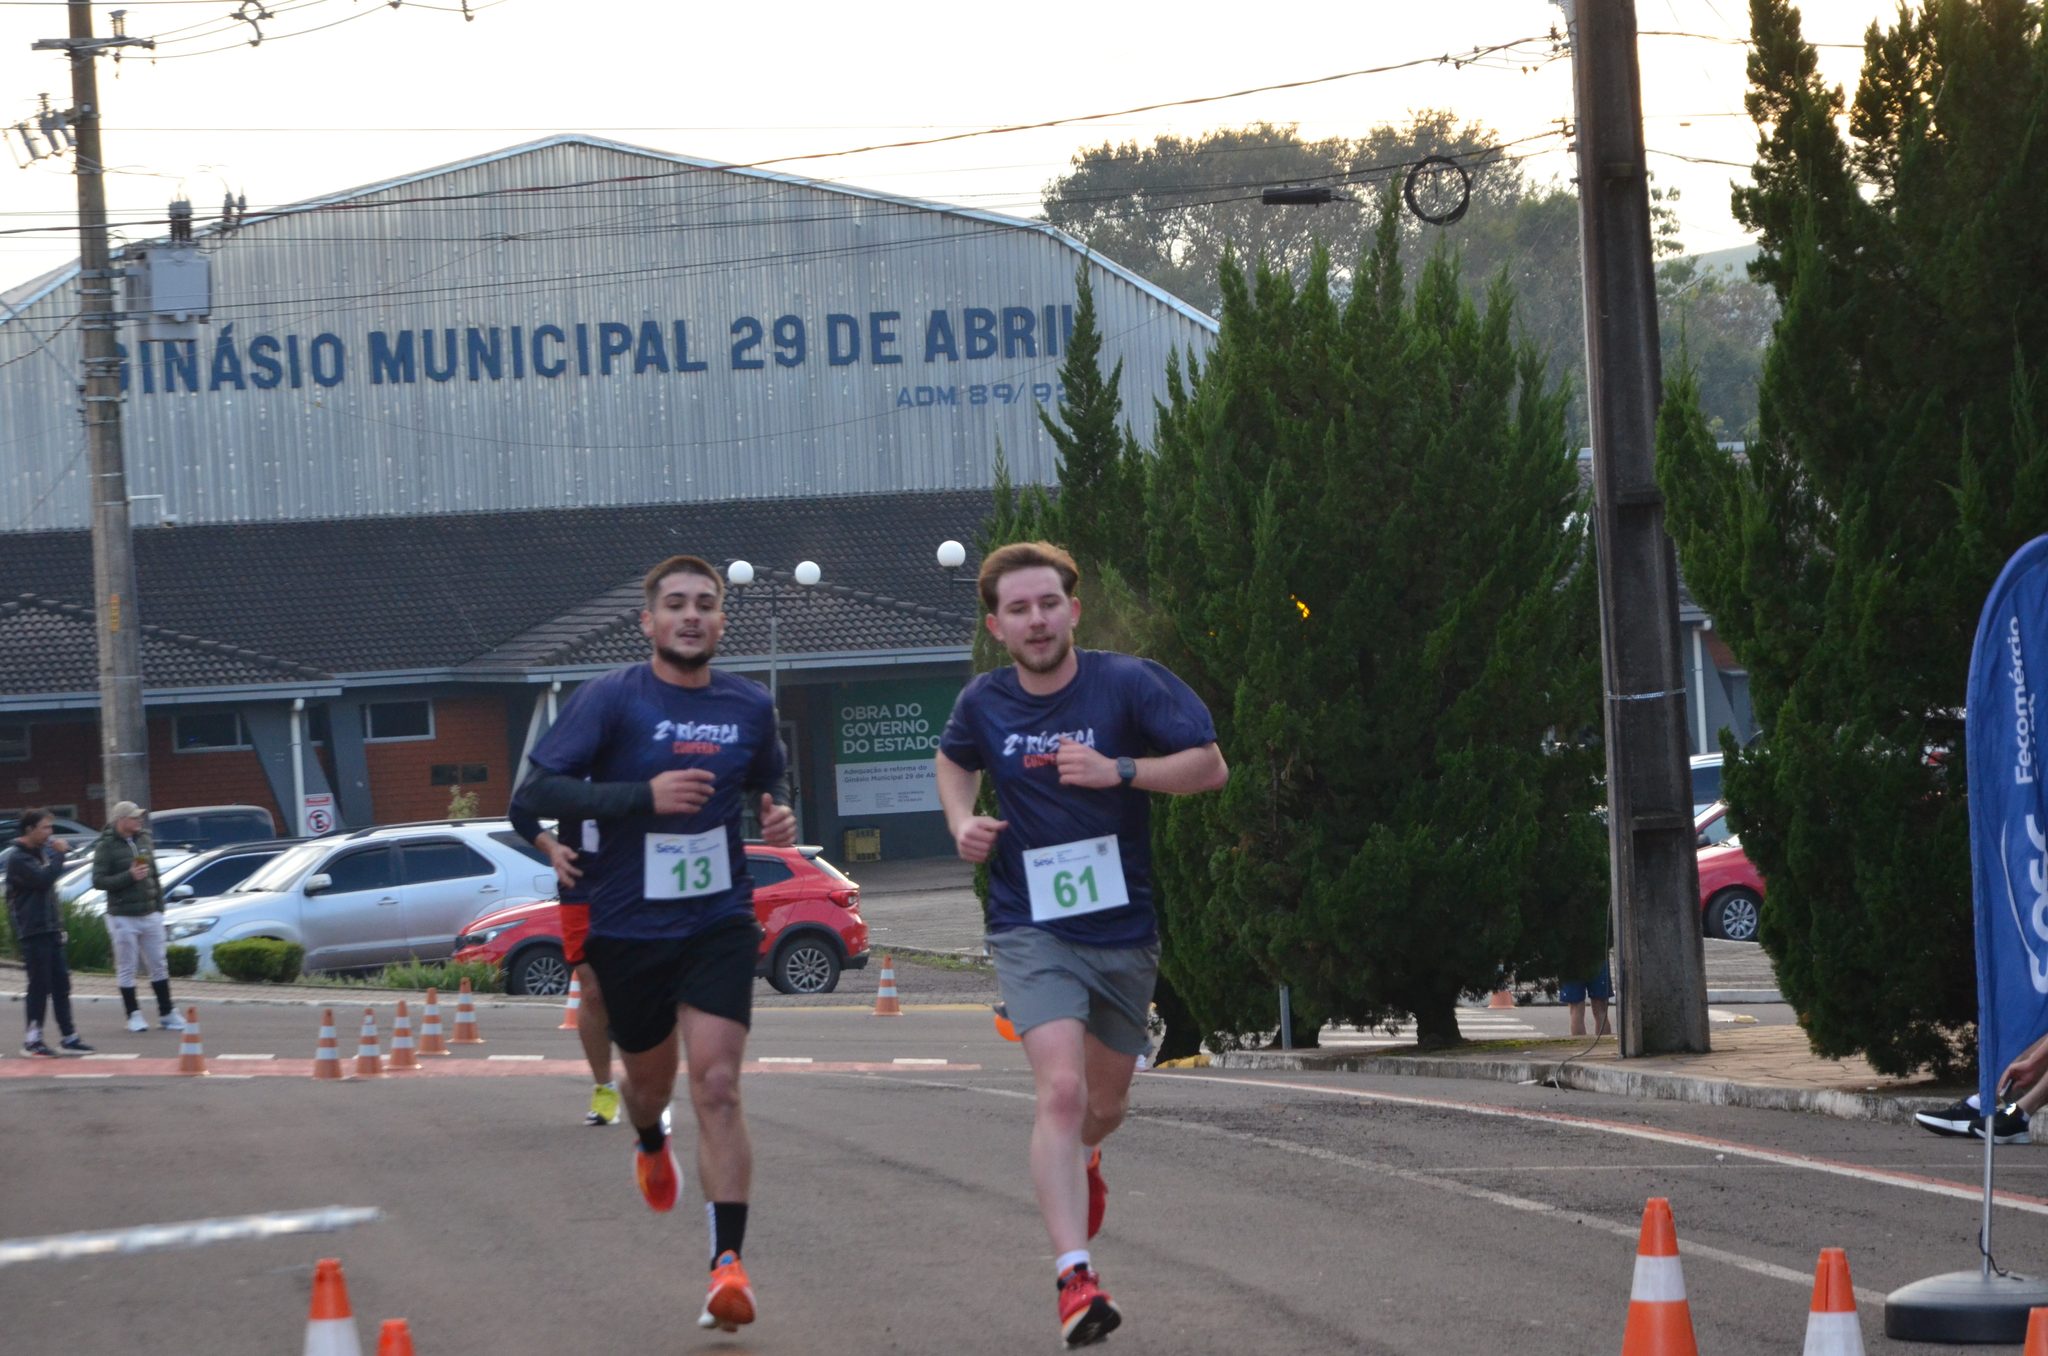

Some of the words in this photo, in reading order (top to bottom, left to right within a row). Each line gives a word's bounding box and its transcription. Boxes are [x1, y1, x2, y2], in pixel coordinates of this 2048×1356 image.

[367, 319, 708, 385] MUNICIPAL
[730, 313, 806, 370] 29
[826, 310, 903, 367] DE
[896, 385, 957, 408] ADM
[841, 705, 892, 721] OBRA
[895, 702, 922, 718] DO
[2008, 616, 2034, 785] Fecomércio
[841, 718, 930, 738] GOVERNO
[842, 738, 870, 754] DO
[873, 735, 941, 753] ESTADO
[671, 856, 712, 892] 13
[1053, 864, 1099, 909] 61
